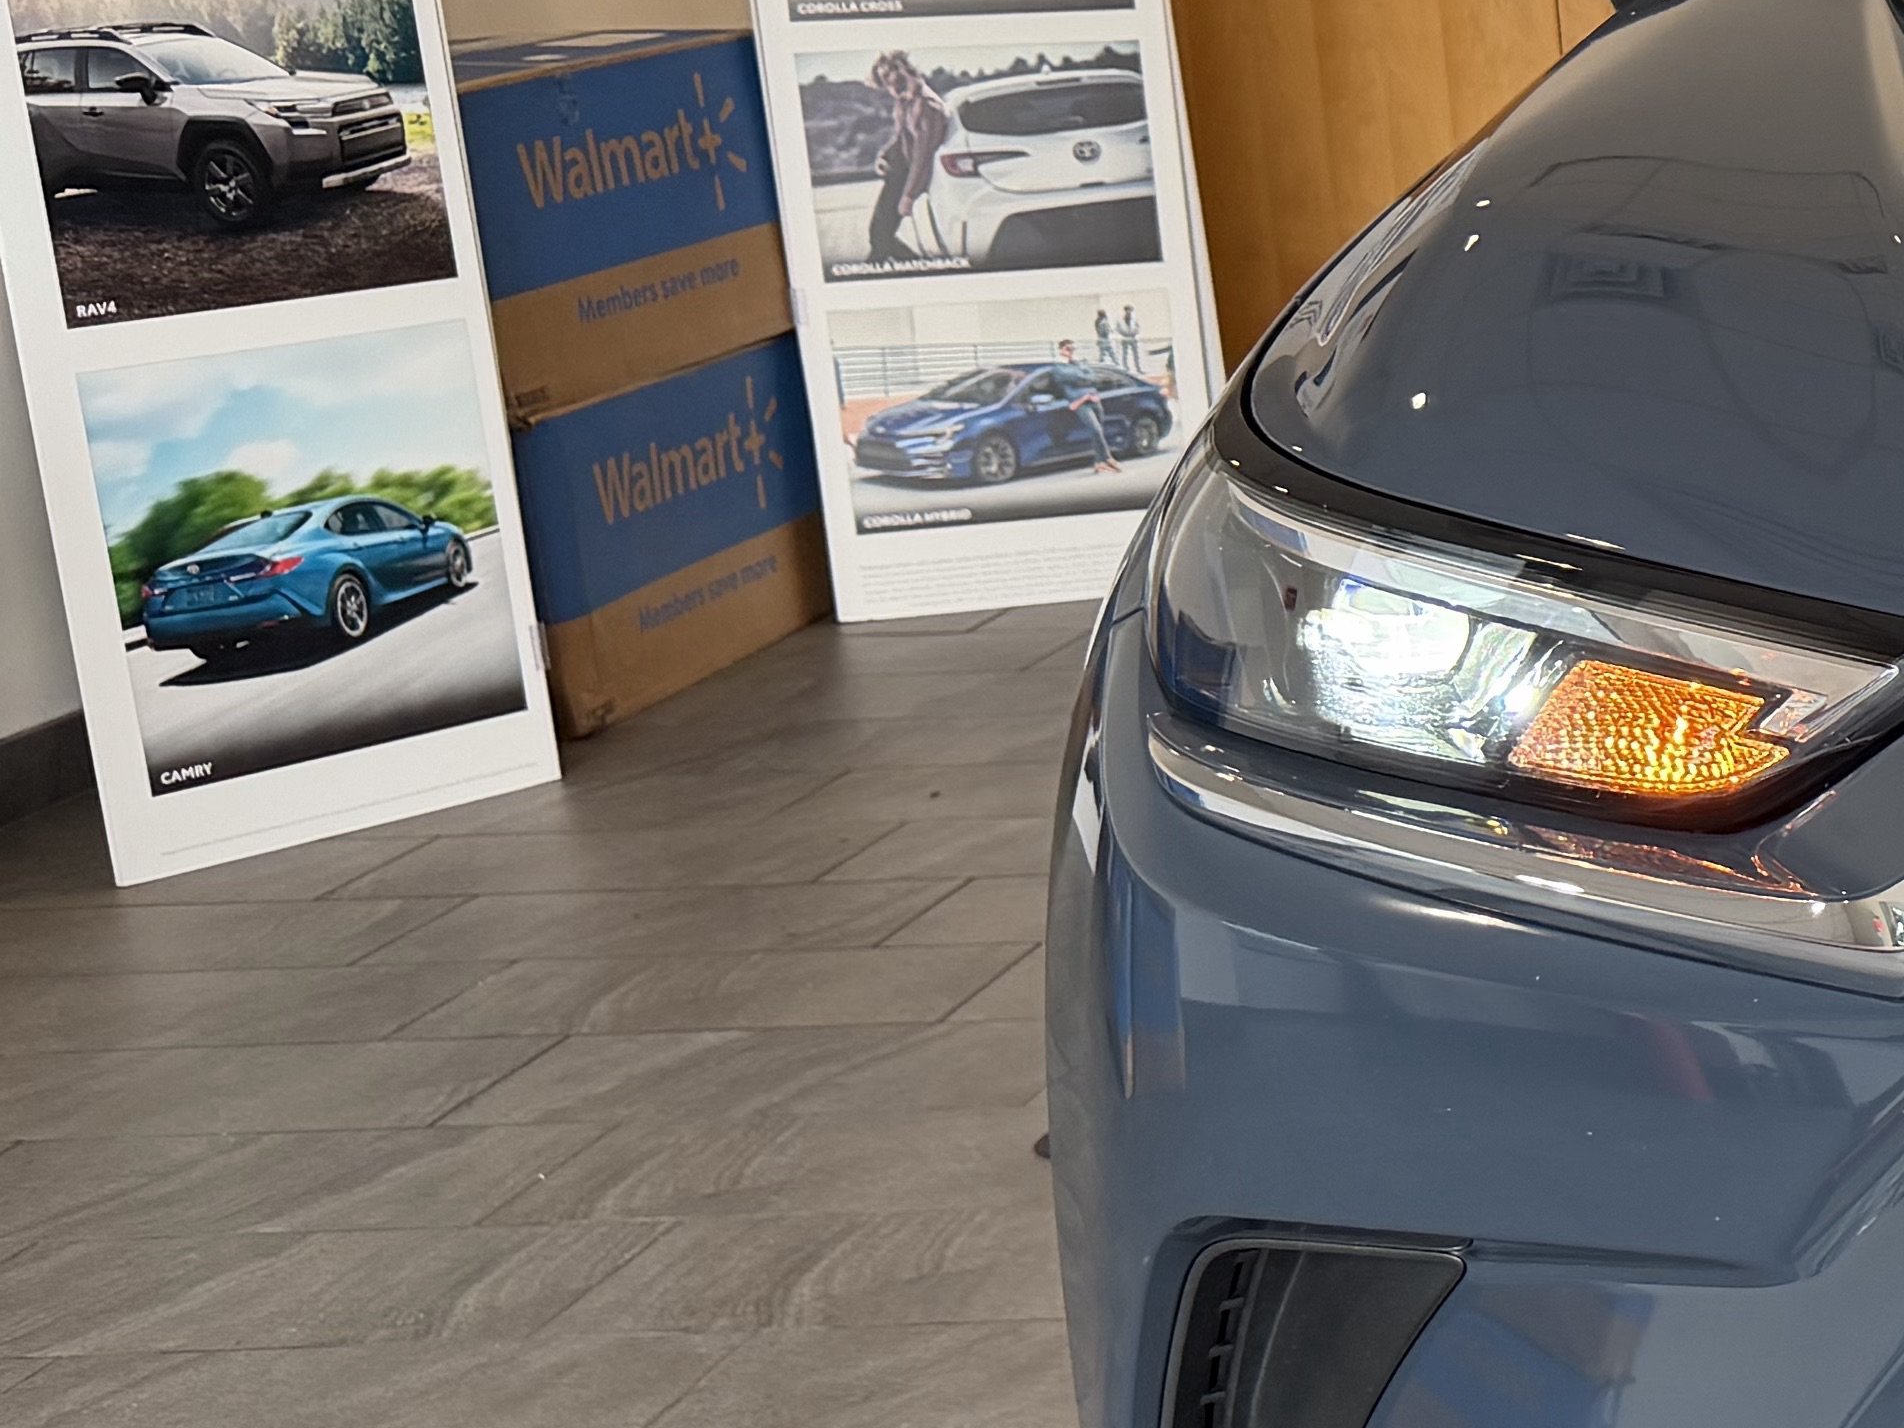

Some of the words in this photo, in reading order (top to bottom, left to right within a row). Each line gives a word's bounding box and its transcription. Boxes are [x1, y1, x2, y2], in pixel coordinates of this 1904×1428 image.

[577, 283, 659, 323] Members
[661, 274, 698, 299] save
[701, 257, 740, 286] more
[76, 300, 118, 318] RAV4
[160, 761, 213, 785] CAMRY
